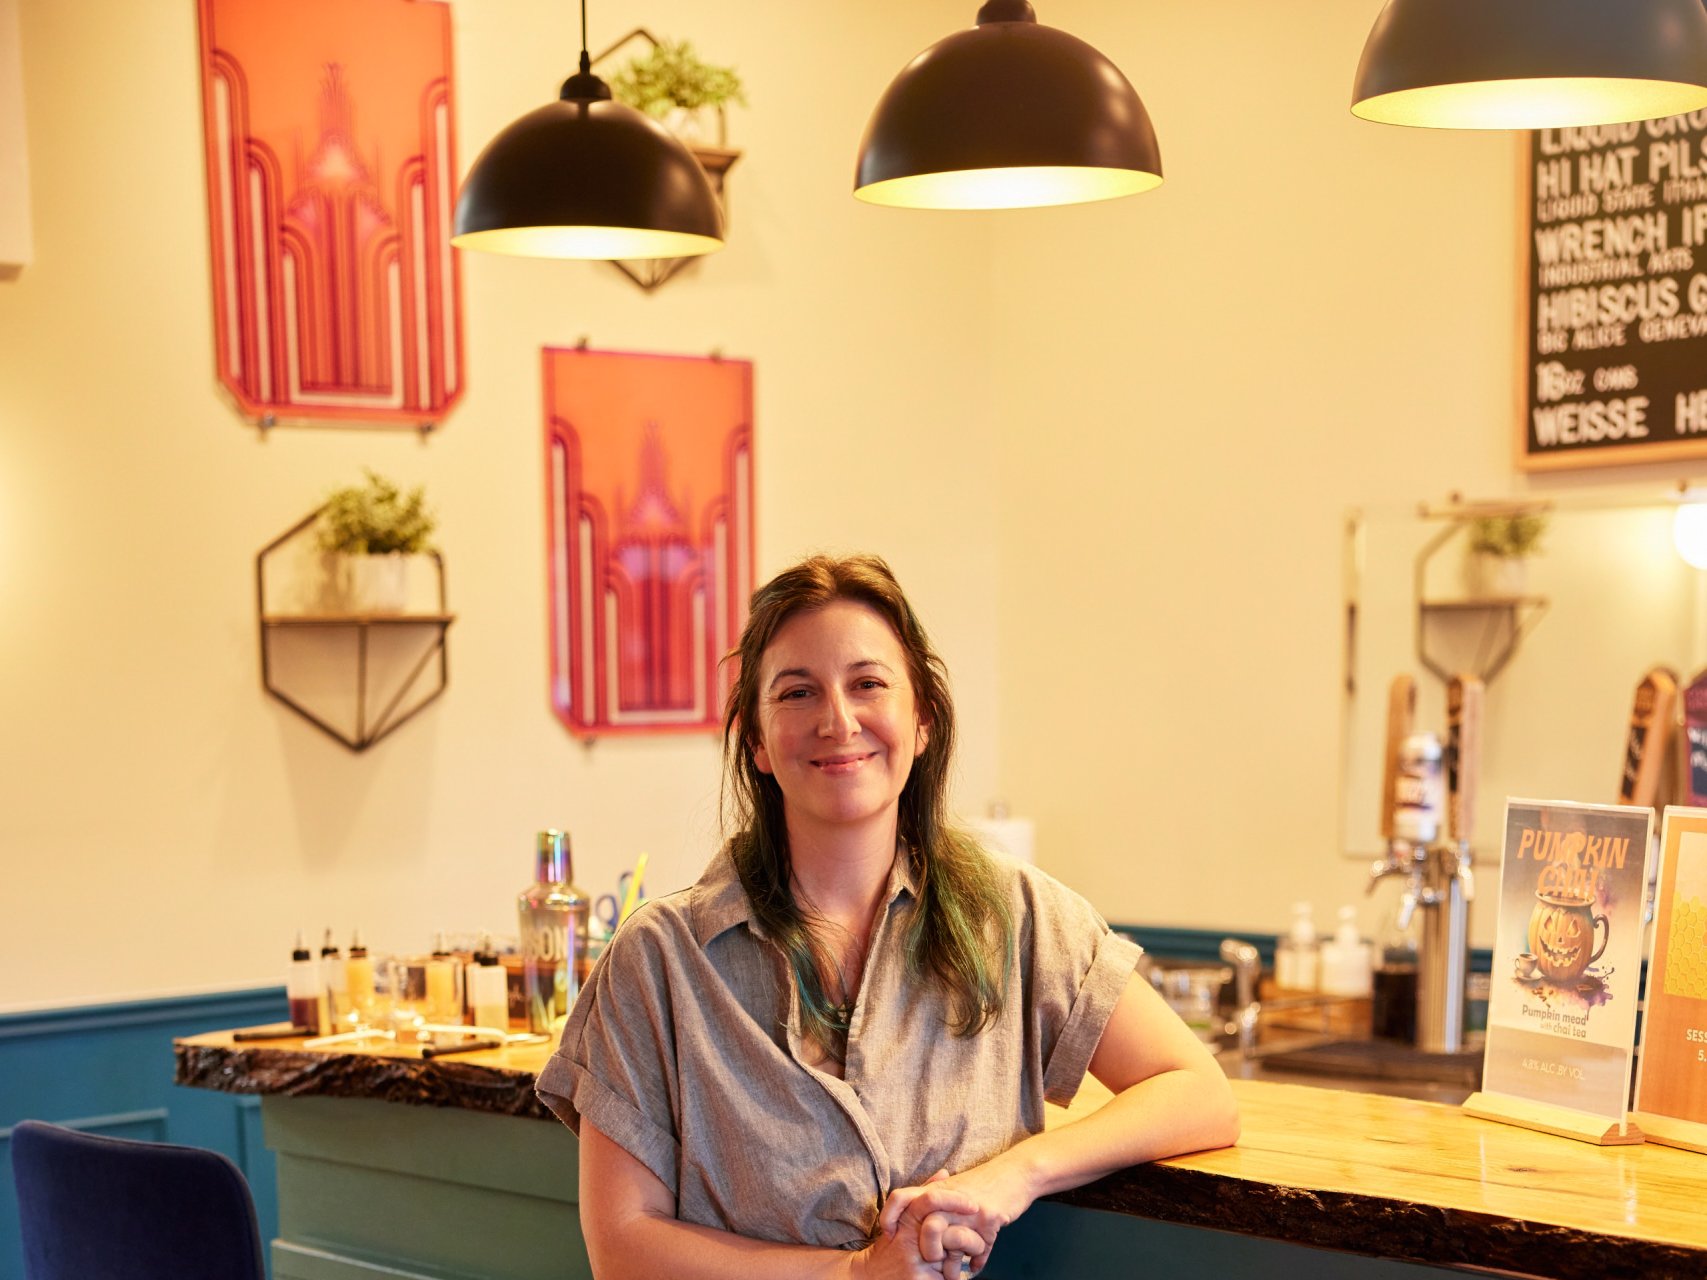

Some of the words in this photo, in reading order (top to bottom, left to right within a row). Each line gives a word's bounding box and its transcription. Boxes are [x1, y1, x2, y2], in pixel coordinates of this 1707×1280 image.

[1536, 157, 1571, 199] HI
[1579, 145, 1640, 195] HAT
[1534, 210, 1668, 264] WRENCH
[1537, 277, 1680, 332] HIBISCUS
[1532, 395, 1650, 446] WEISSE
[1517, 828, 1630, 869] PUMPKIN
[1537, 864, 1599, 899] CHAI
[1522, 1004, 1560, 1021] Pumpkin
[1562, 1013, 1587, 1026] mead
[1553, 1022, 1571, 1036] chai
[1572, 1026, 1587, 1039] tea
